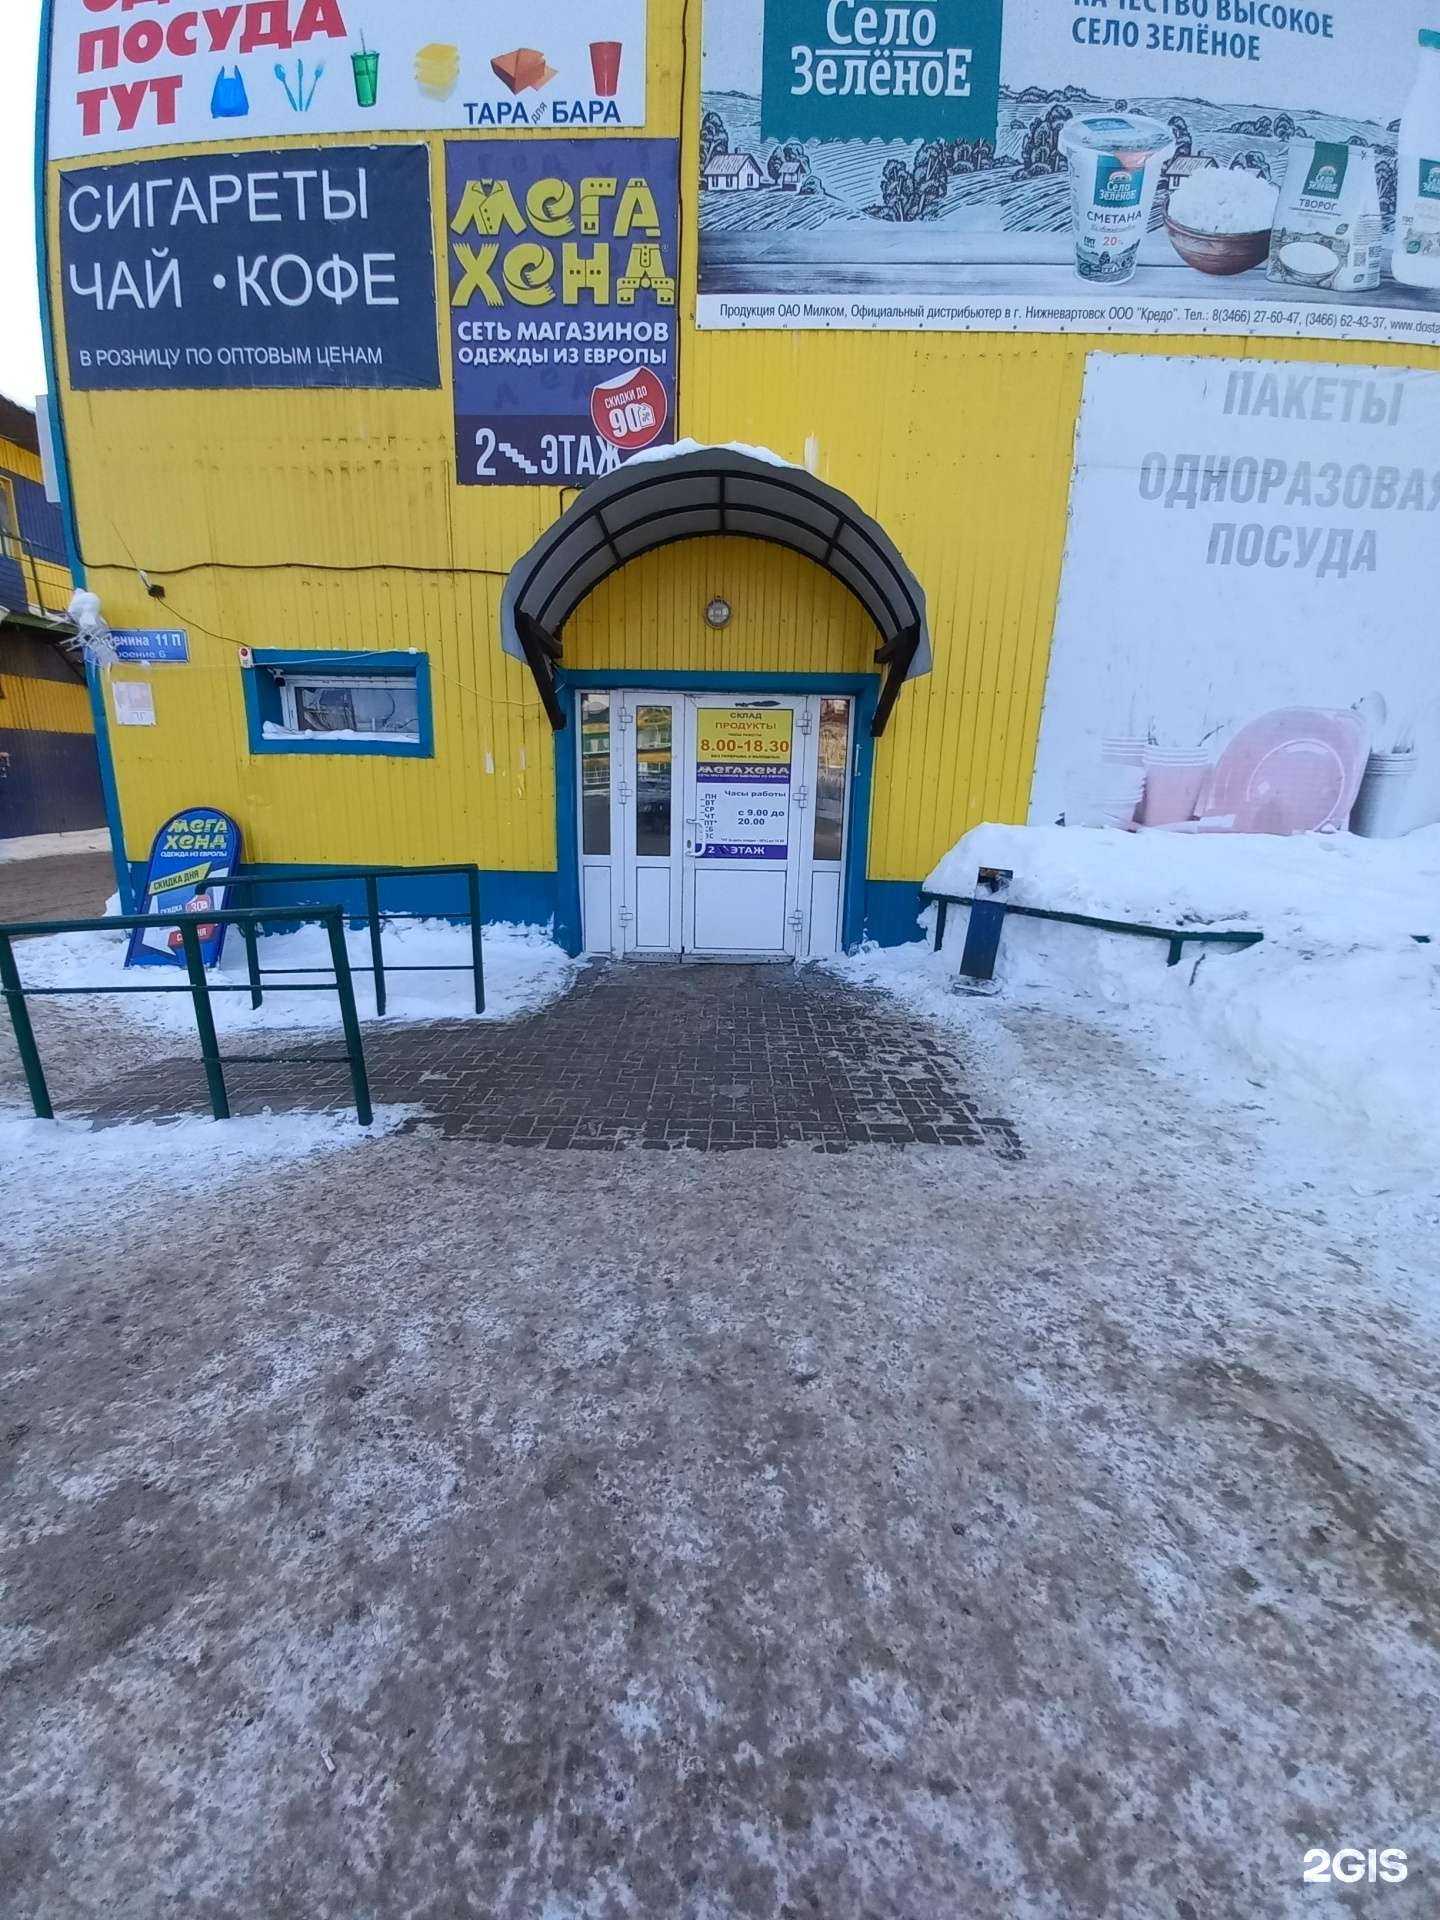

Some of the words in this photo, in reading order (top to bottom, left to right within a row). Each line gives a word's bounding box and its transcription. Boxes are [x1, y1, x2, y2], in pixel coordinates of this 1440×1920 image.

[826, 0, 937, 46] Село
[1216, 0, 1334, 38] ВЫСОКОЕ
[77, 0, 348, 74] ПОСУДА
[1072, 17, 1139, 48] СЕЛО
[1146, 23, 1261, 61] ЗЕЛЁНОЕ
[76, 75, 183, 136] ТУТ
[463, 101, 530, 125] ТАРА
[530, 101, 548, 124] для
[552, 100, 622, 123] БАРА
[68, 168, 369, 233] СИГАРЕТЫ
[1300, 198, 1338, 211] ТВОРОГ
[1087, 211, 1142, 224] СМЕТАНА
[69, 247, 182, 310] ЧАЙ
[237, 253, 399, 307] КОФЕ
[720, 303, 775, 318] Продукция
[778, 304, 800, 317] ОАО
[804, 304, 848, 318] Милком,
[851, 304, 924, 320] Официальный
[927, 305, 1001, 321] дистрибьютер
[1004, 309, 1011, 318] в
[1014, 309, 1021, 318] г.
[1025, 306, 1106, 322] Нижневартовск
[1108, 307, 1133, 320] ООО
[1212, 308, 1251, 323] 8(3466)
[1253, 310, 1302, 326] 27-60-47,
[1305, 311, 1337, 327] (3466)
[1340, 314, 1387, 330] 62-43-37,
[457, 321, 512, 342] СЕТЬ
[517, 322, 669, 342] МАГАЗИНОВ
[80, 350, 91, 366] В
[97, 348, 181, 369] РОЗНИЦУ
[185, 348, 213, 365] ПО
[217, 346, 312, 365] ОПТОВЫМ
[316, 346, 383, 370] ЦЕНАМ
[458, 347, 548, 366] ОДЕЖДЫ
[553, 348, 579, 364] ИЗ
[584, 348, 667, 365] ЕВРОПЫ
[604, 389, 636, 409] СКИДКИ
[635, 385, 648, 400] ДО
[1222, 370, 1404, 427] ПАКЕТЫ
[475, 428, 497, 476] 2
[540, 434, 621, 476] ЭТАЖ
[1205, 522, 1377, 579] ПОСУДА
[715, 722, 776, 730] ПРОДУКТЫ
[701, 739, 789, 752] 8.00-18.30
[751, 791, 786, 799] работы
[747, 809, 768, 817] 9.00
[730, 846, 765, 855] ЭТАЖ
[153, 875, 183, 890] СКИДКА
[183, 869, 199, 882] ДНЯ
